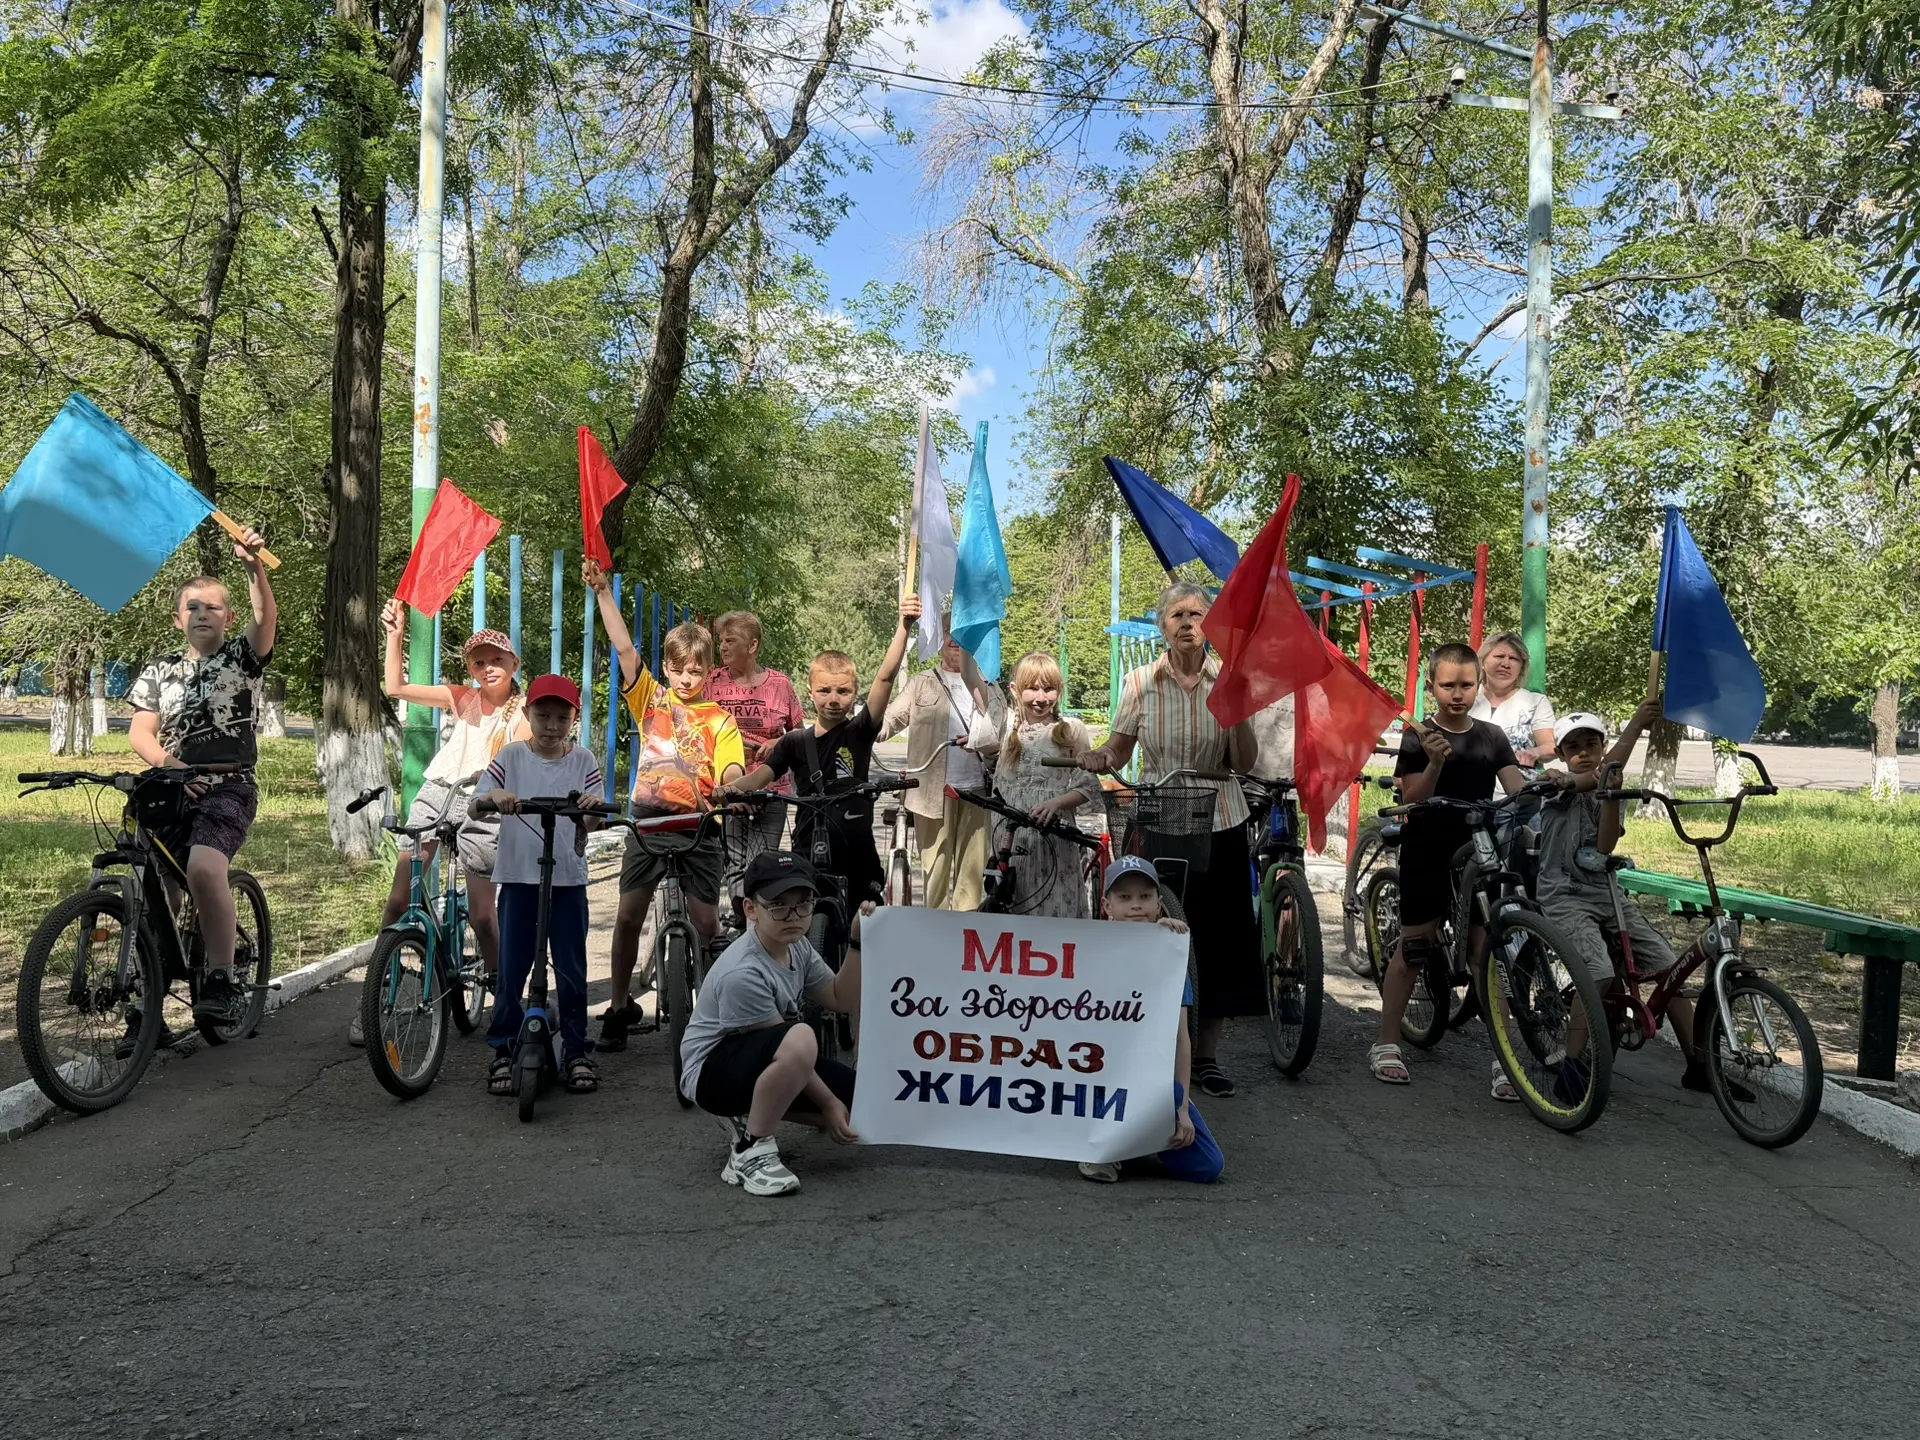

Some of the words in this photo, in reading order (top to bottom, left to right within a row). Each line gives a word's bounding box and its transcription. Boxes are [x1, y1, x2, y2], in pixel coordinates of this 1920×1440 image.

[721, 705, 761, 717] ARVA
[890, 977, 949, 1018] За
[960, 984, 1146, 1032] здоровый
[913, 1030, 1105, 1073] ОБРАЗ
[894, 1069, 1129, 1122] ЖИЗНИ
